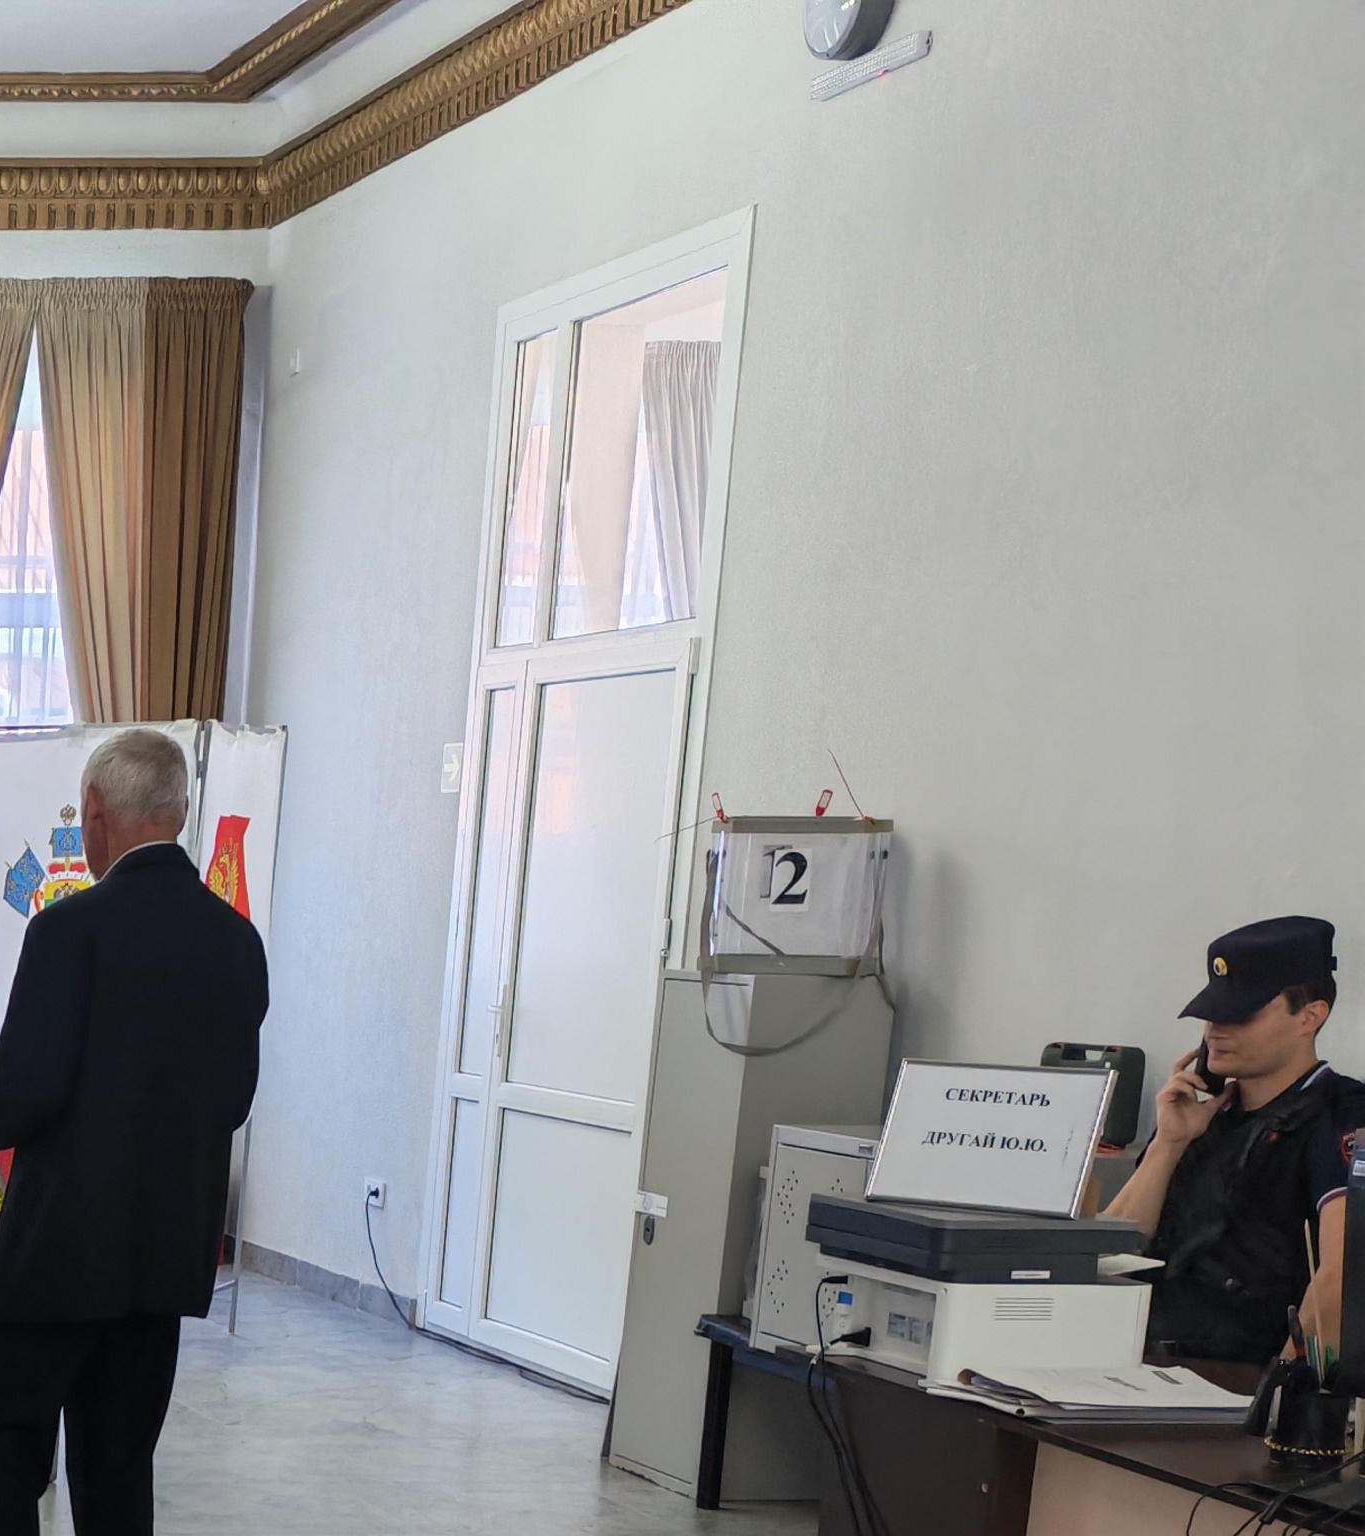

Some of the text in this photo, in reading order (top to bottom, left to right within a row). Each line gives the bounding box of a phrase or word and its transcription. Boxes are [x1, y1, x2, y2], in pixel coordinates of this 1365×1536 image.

[771, 851, 808, 905] 2
[945, 1087, 1051, 1107] СЕКРЕТАРЬ
[922, 1131, 1047, 1153] ДРУГАЙ Ю.Ю.
